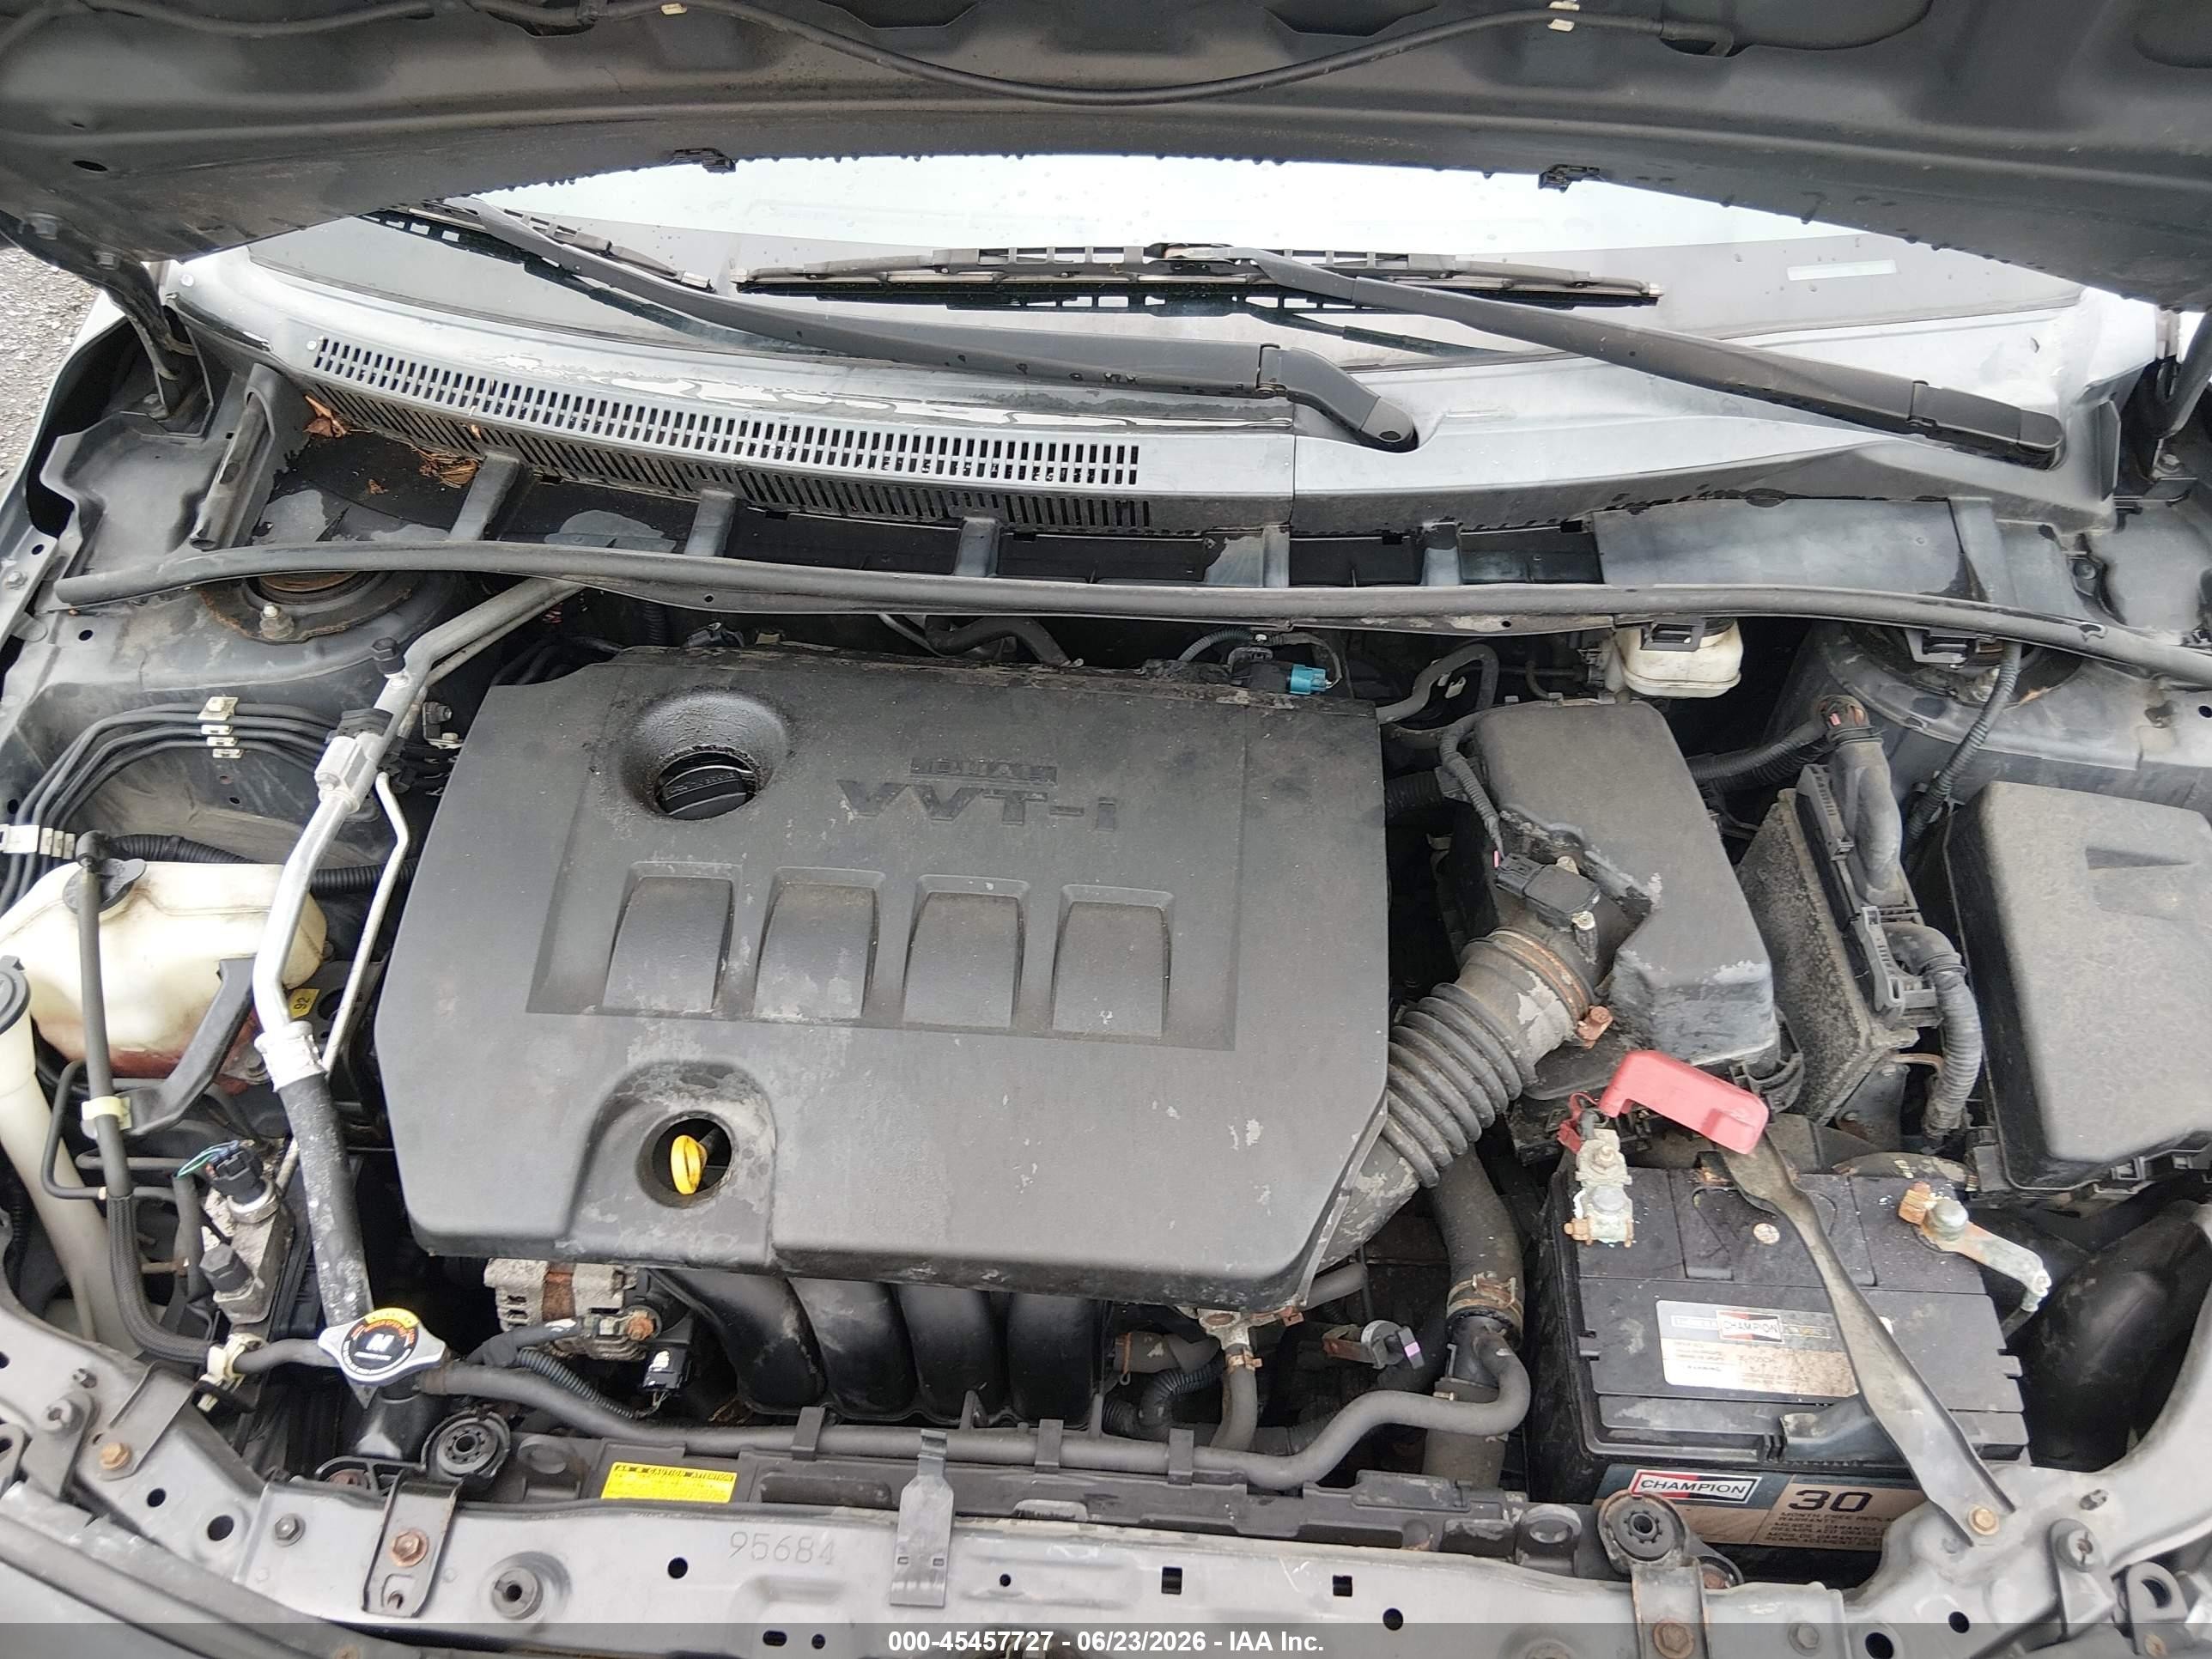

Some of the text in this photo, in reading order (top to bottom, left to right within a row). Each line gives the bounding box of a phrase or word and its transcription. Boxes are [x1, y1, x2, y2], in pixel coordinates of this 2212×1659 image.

[1722, 1320, 1780, 1333] CHAMPION
[1639, 1479, 1746, 1494] CHAMPION
[1789, 1489, 1873, 1512] 30
[729, 1530, 836, 1565] 95684
